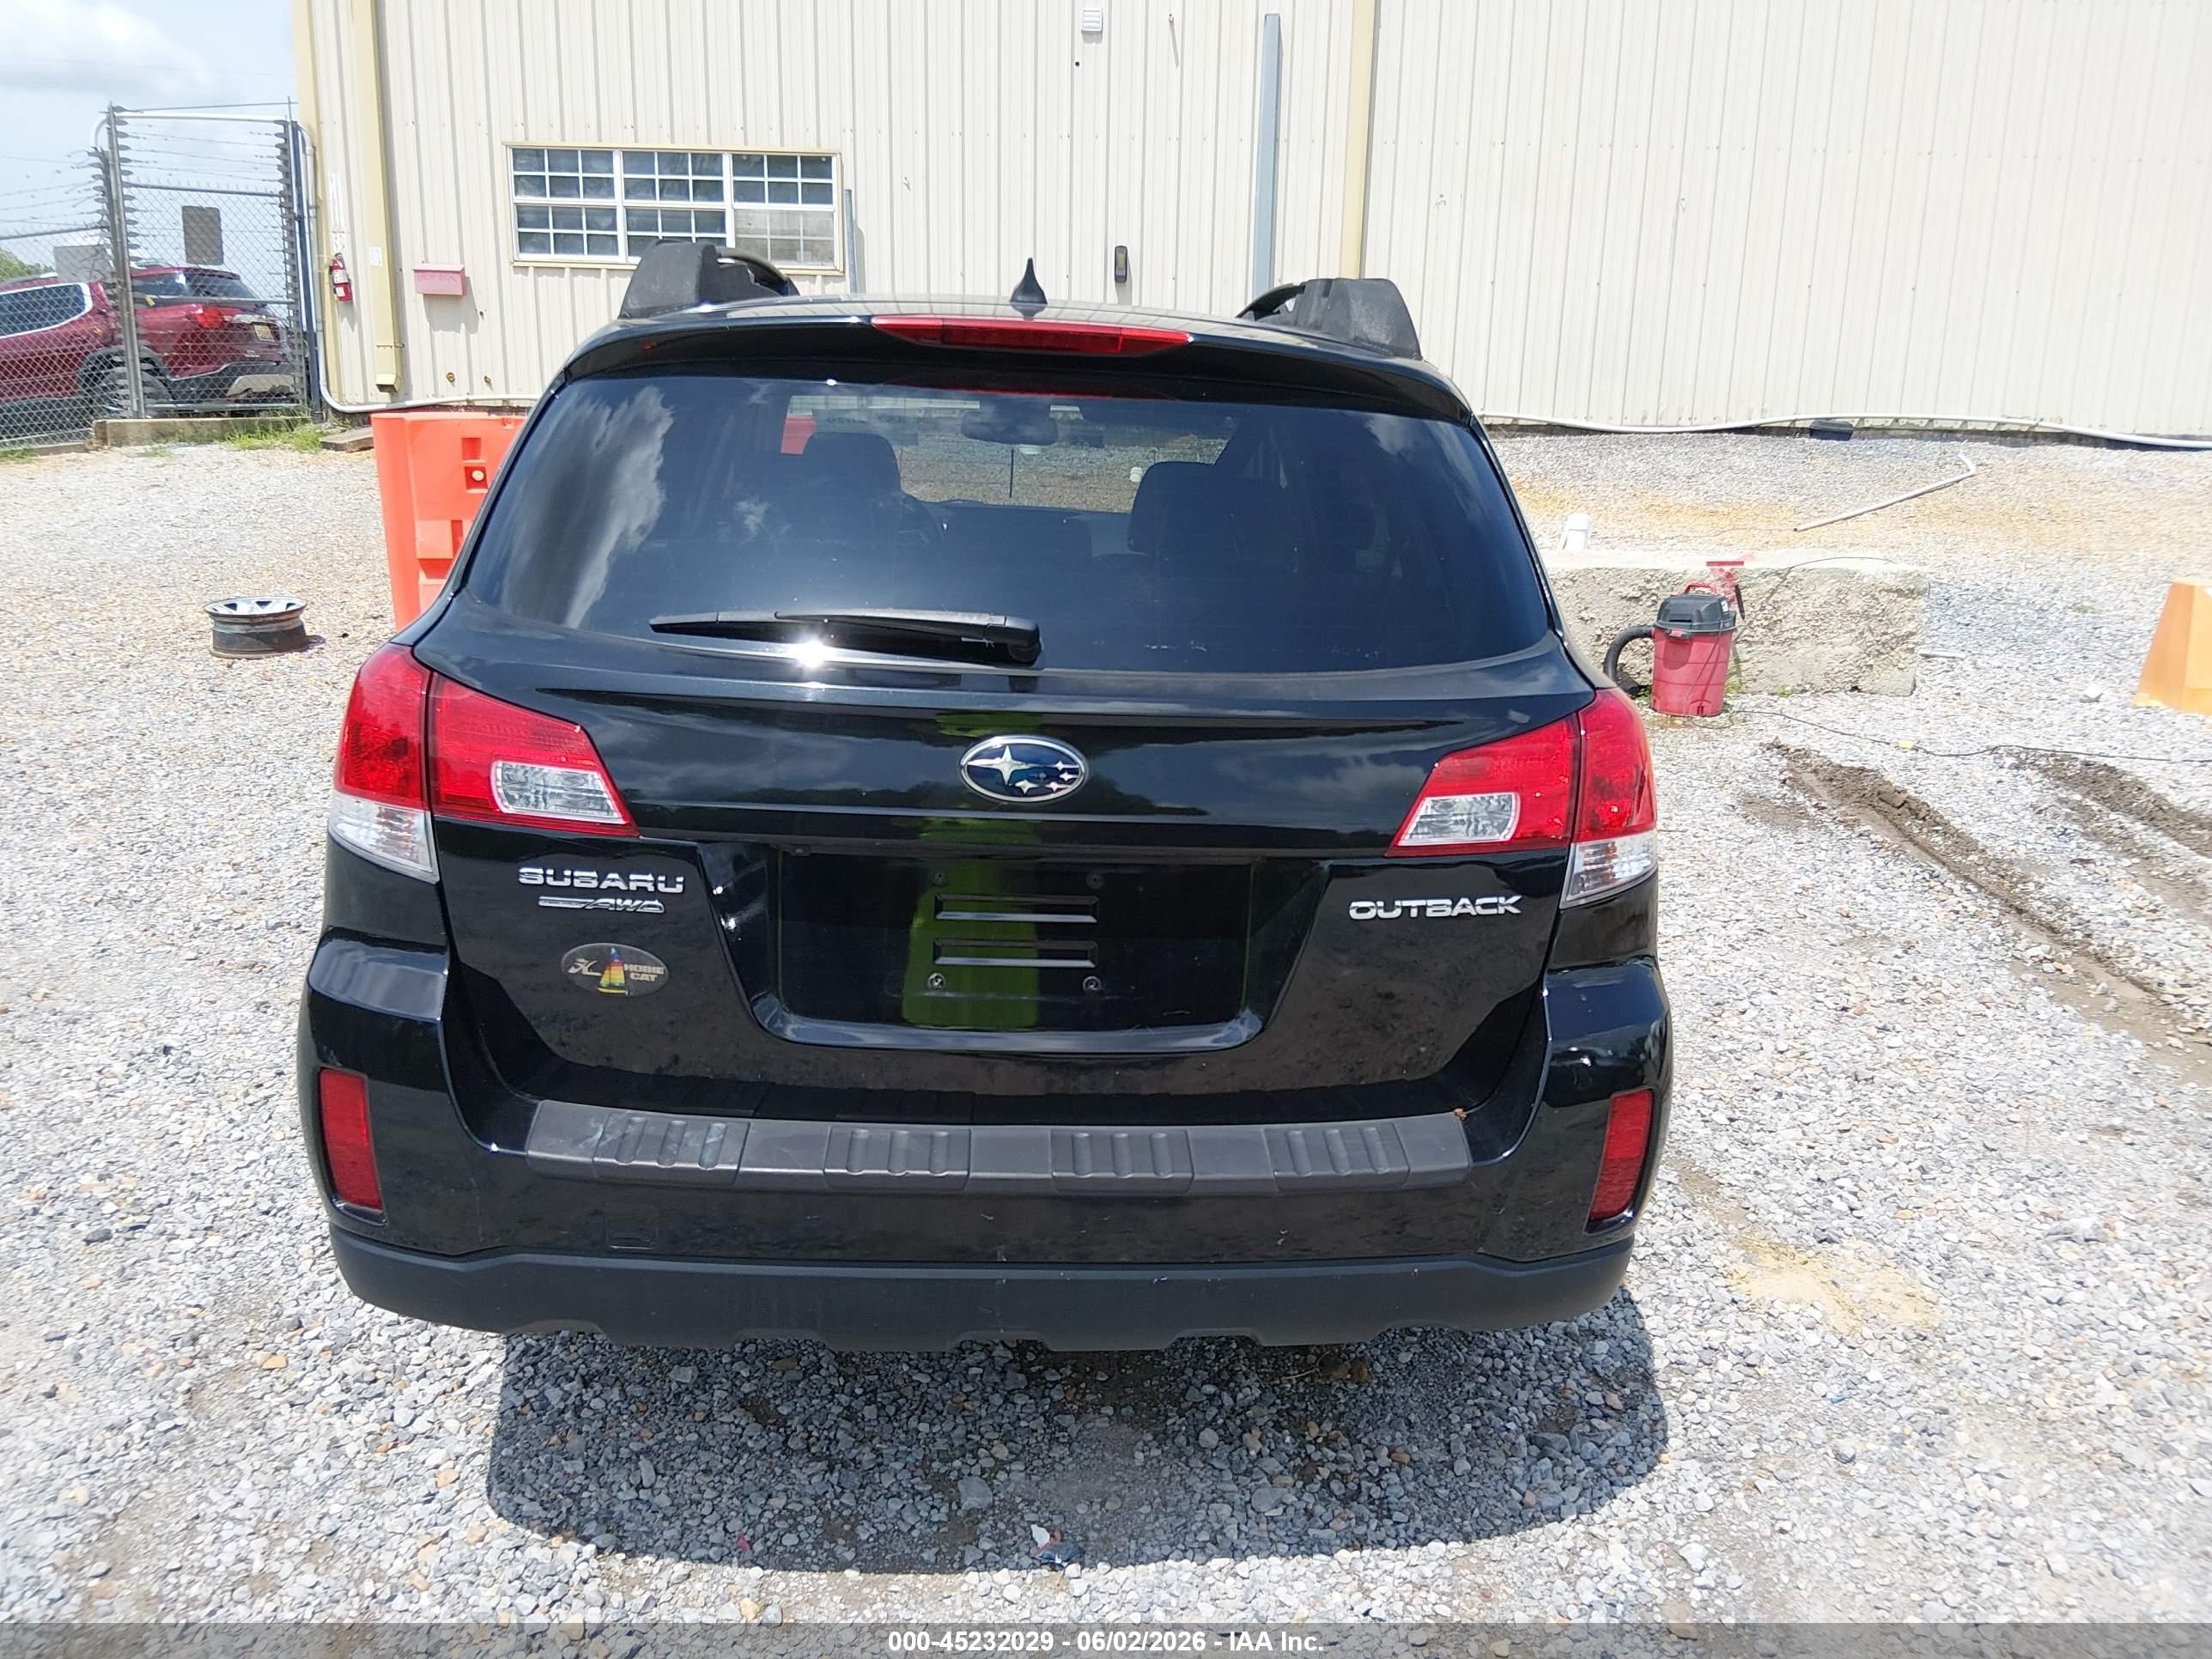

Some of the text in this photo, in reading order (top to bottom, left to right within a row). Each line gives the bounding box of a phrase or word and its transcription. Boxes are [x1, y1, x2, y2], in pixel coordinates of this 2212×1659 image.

[518, 867, 684, 893] SUBARU
[586, 896, 665, 914] AWD
[1349, 895, 1522, 921] OUTBACK
[623, 963, 665, 975] HOBIE
[629, 972, 658, 982] CAT
